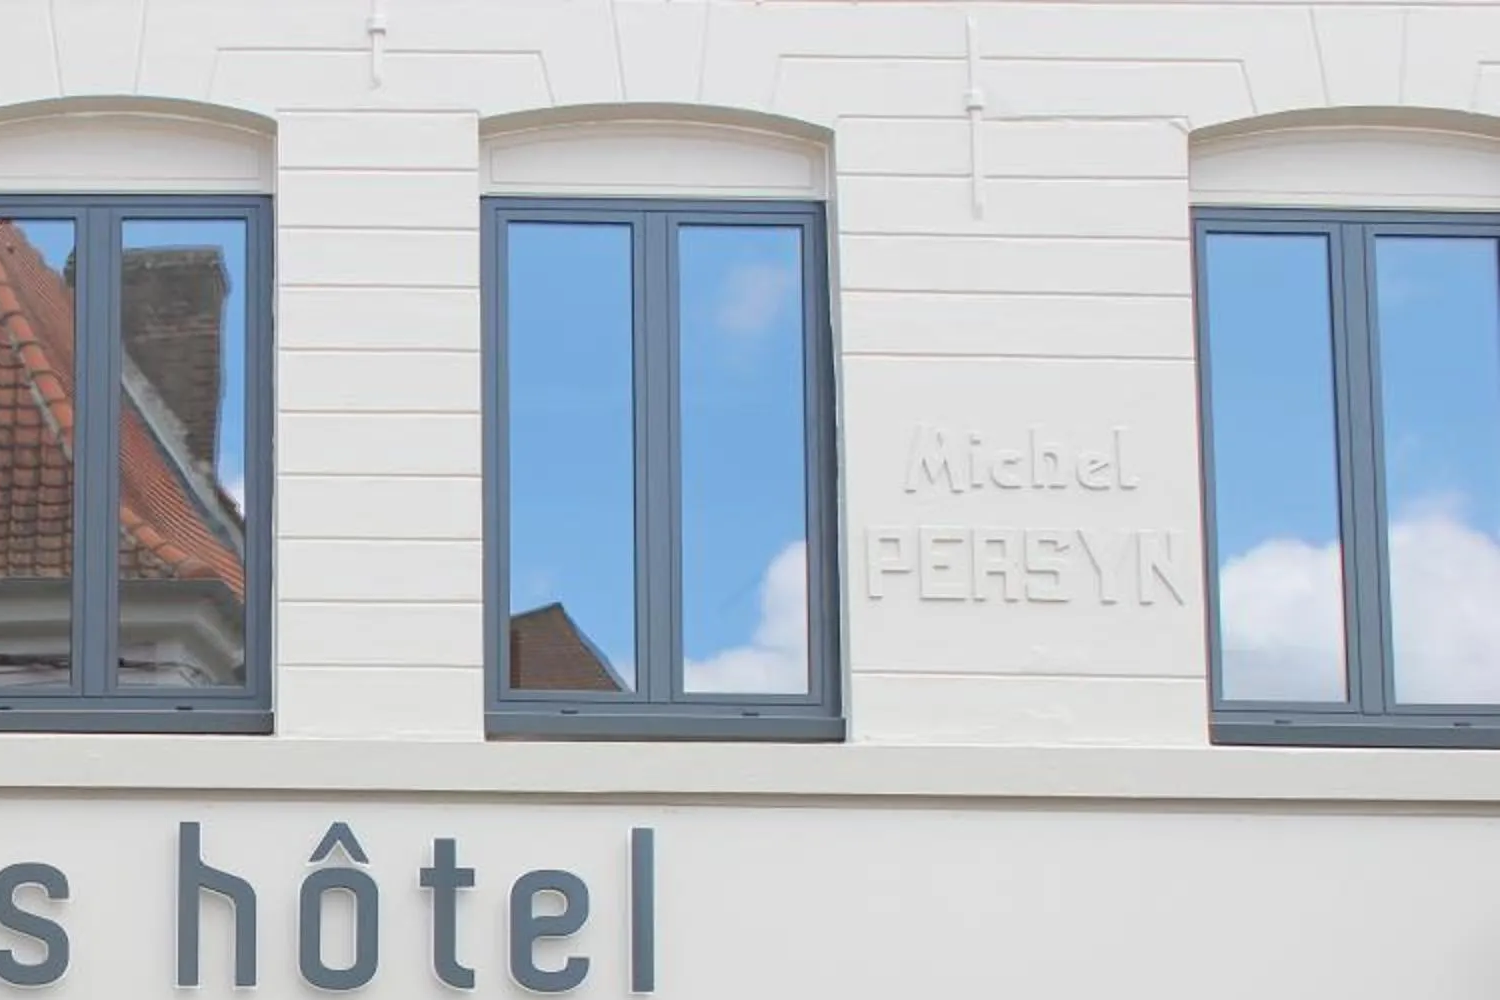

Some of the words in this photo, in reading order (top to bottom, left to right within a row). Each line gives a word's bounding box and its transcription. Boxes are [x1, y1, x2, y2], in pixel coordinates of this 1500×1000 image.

[904, 422, 1140, 494] Michel
[863, 524, 1186, 607] PERSYN
[174, 820, 656, 992] hôtel
